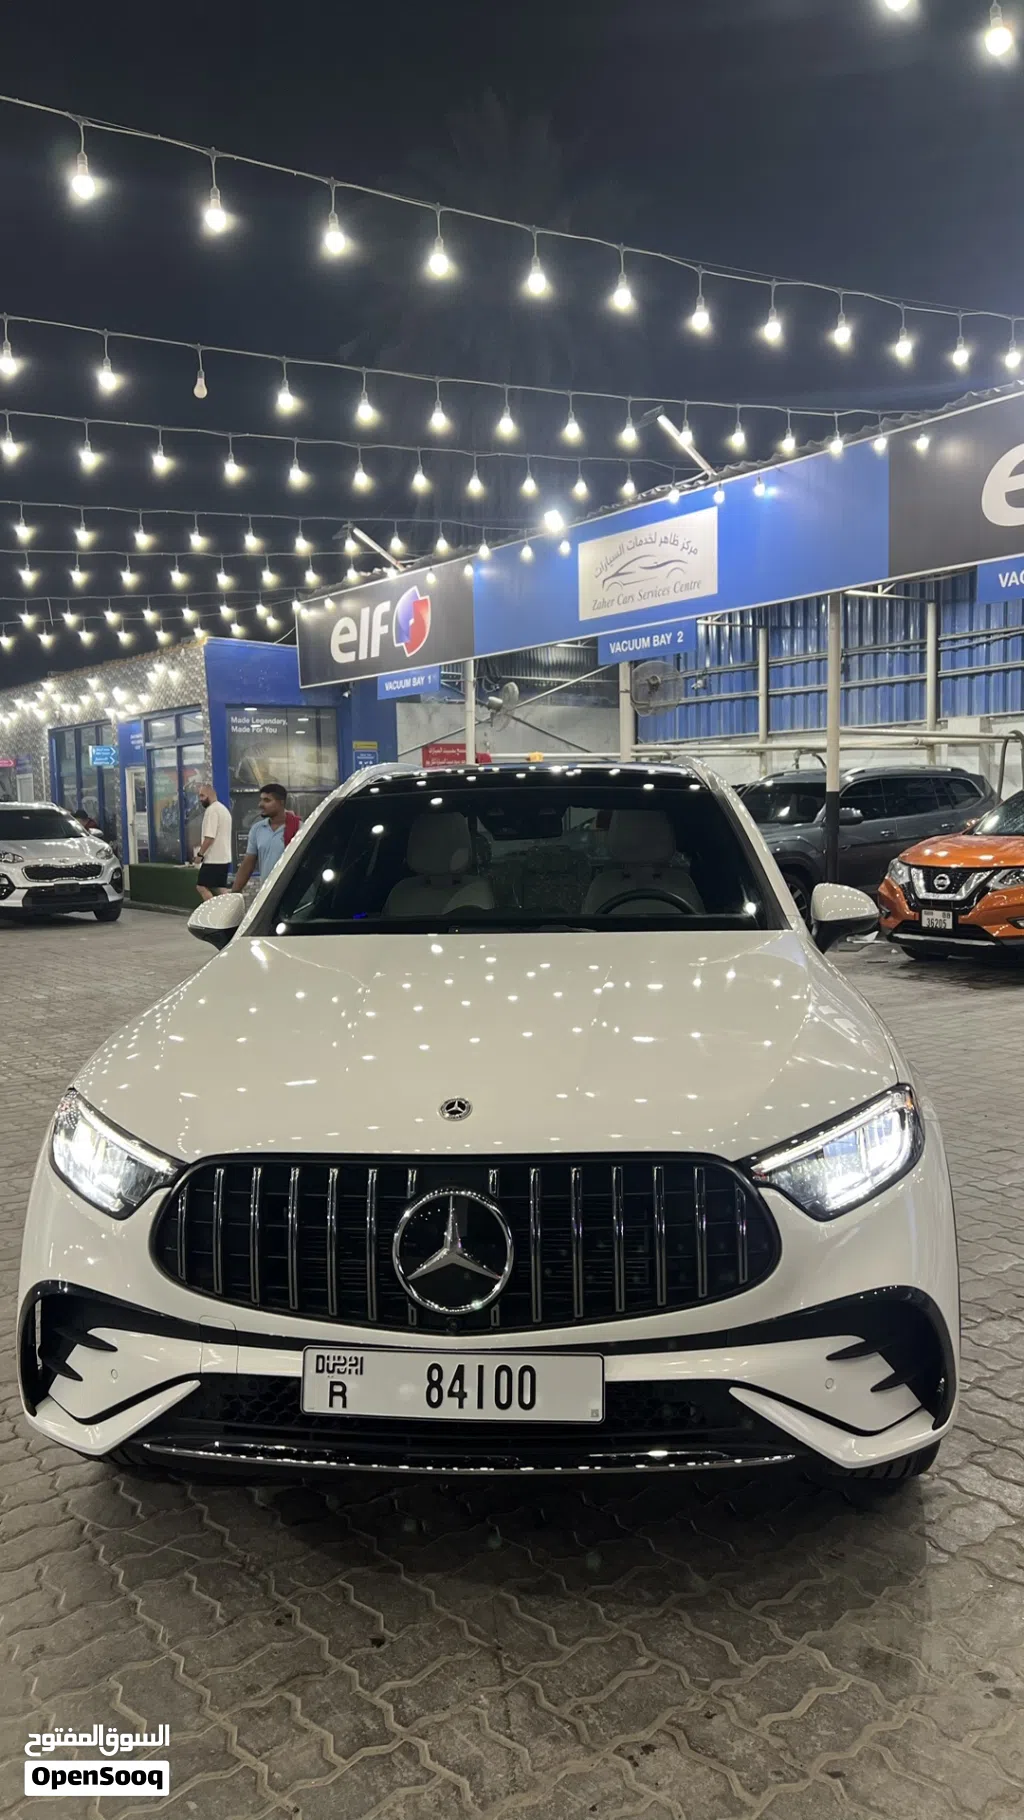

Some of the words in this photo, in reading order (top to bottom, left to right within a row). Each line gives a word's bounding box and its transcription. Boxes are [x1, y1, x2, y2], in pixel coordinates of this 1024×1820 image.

[627, 532, 657, 551] لخدمات
[658, 532, 679, 547] ظاهر
[680, 539, 698, 555] مركز
[594, 544, 625, 579] السيارات
[592, 599, 615, 611] Zaher
[617, 594, 634, 606] Cars
[638, 586, 670, 602] Services
[673, 580, 701, 594] Centre
[330, 600, 391, 664] elf
[609, 636, 650, 654] VACUUM
[652, 632, 672, 647] BAY
[677, 631, 684, 643] 2
[384, 678, 411, 691] VACUUM
[412, 676, 425, 687] BAY
[427, 674, 431, 685] 1
[251, 717, 288, 726] Legendary,
[926, 917, 947, 928] 36205
[328, 1380, 347, 1409] R
[425, 1362, 537, 1411] 84100
